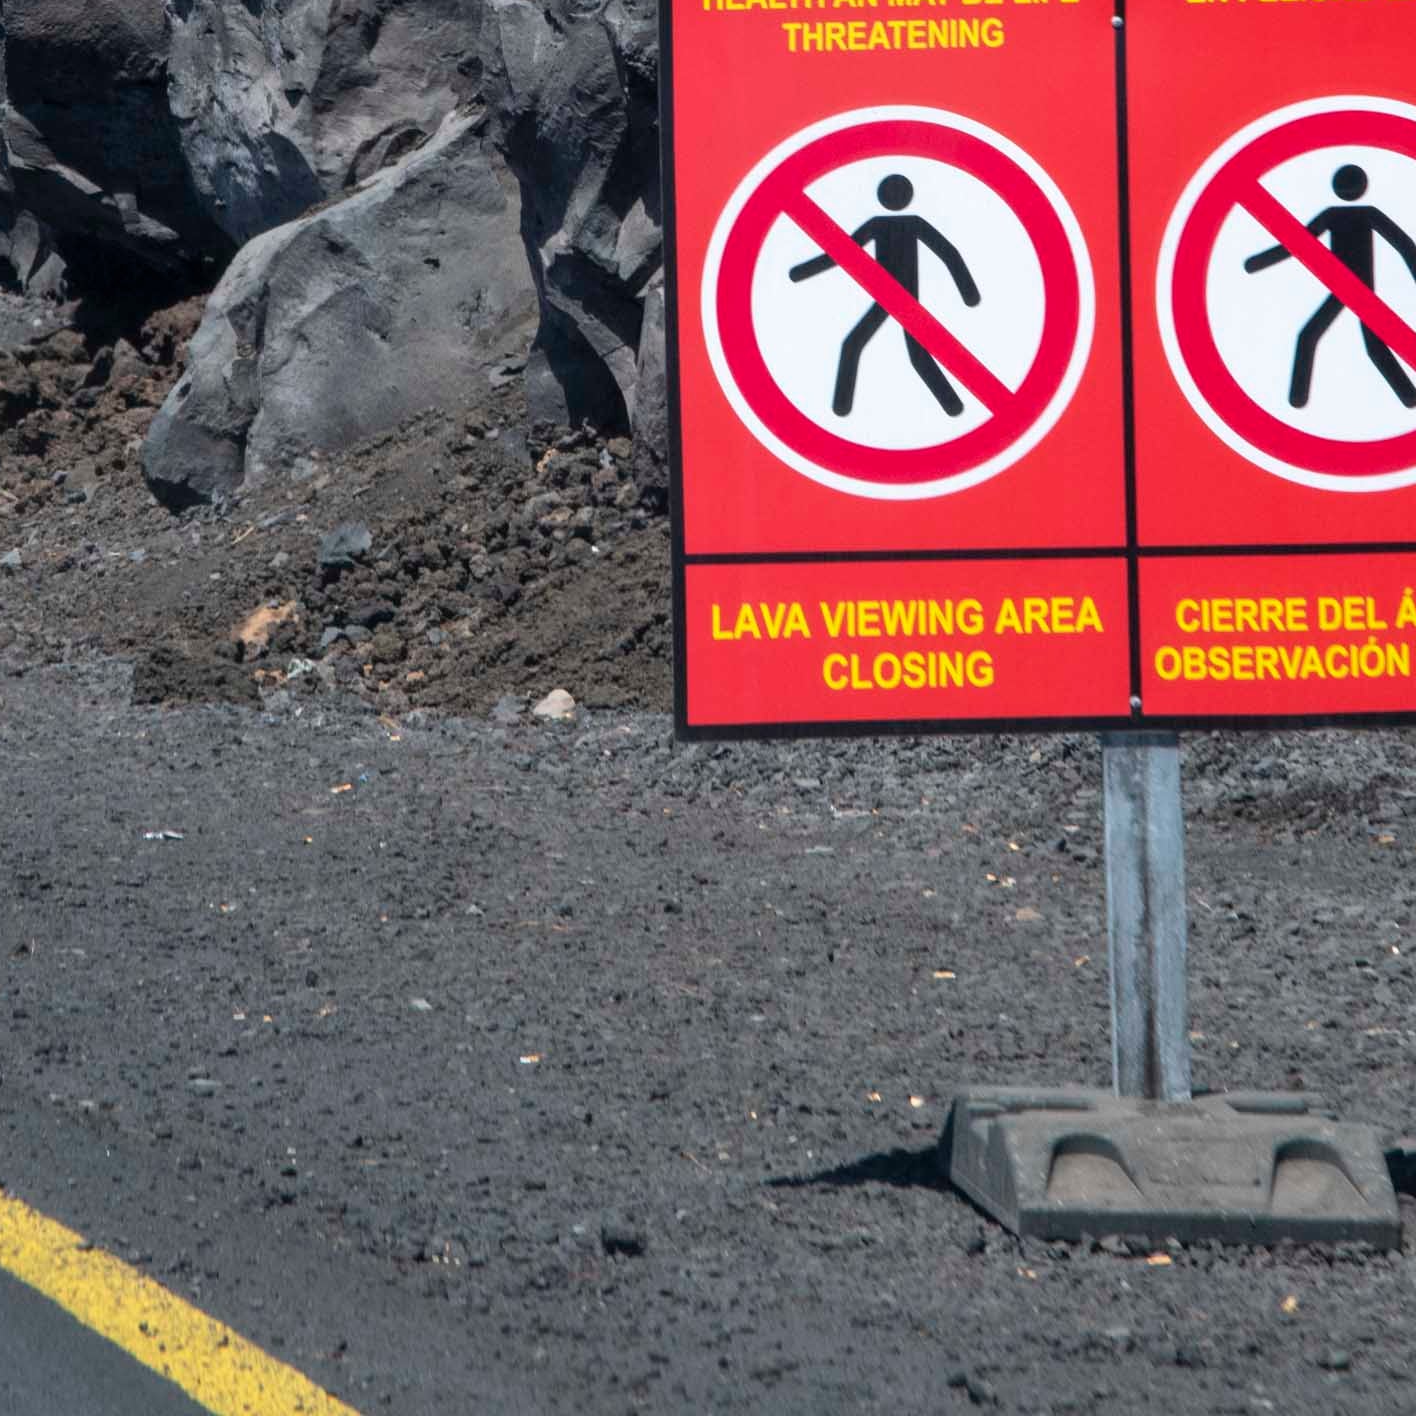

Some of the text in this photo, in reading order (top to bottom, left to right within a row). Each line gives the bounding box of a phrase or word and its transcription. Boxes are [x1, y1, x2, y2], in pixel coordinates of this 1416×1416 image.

[781, 17, 1005, 52] THREATENING
[711, 596, 1104, 640] LAVA VIEWING AREA
[1175, 597, 1309, 633] CIERRE
[1318, 596, 1388, 631] DEL
[822, 650, 994, 690] CLOSING
[1154, 636, 1410, 681] OBSERVACIÓN
